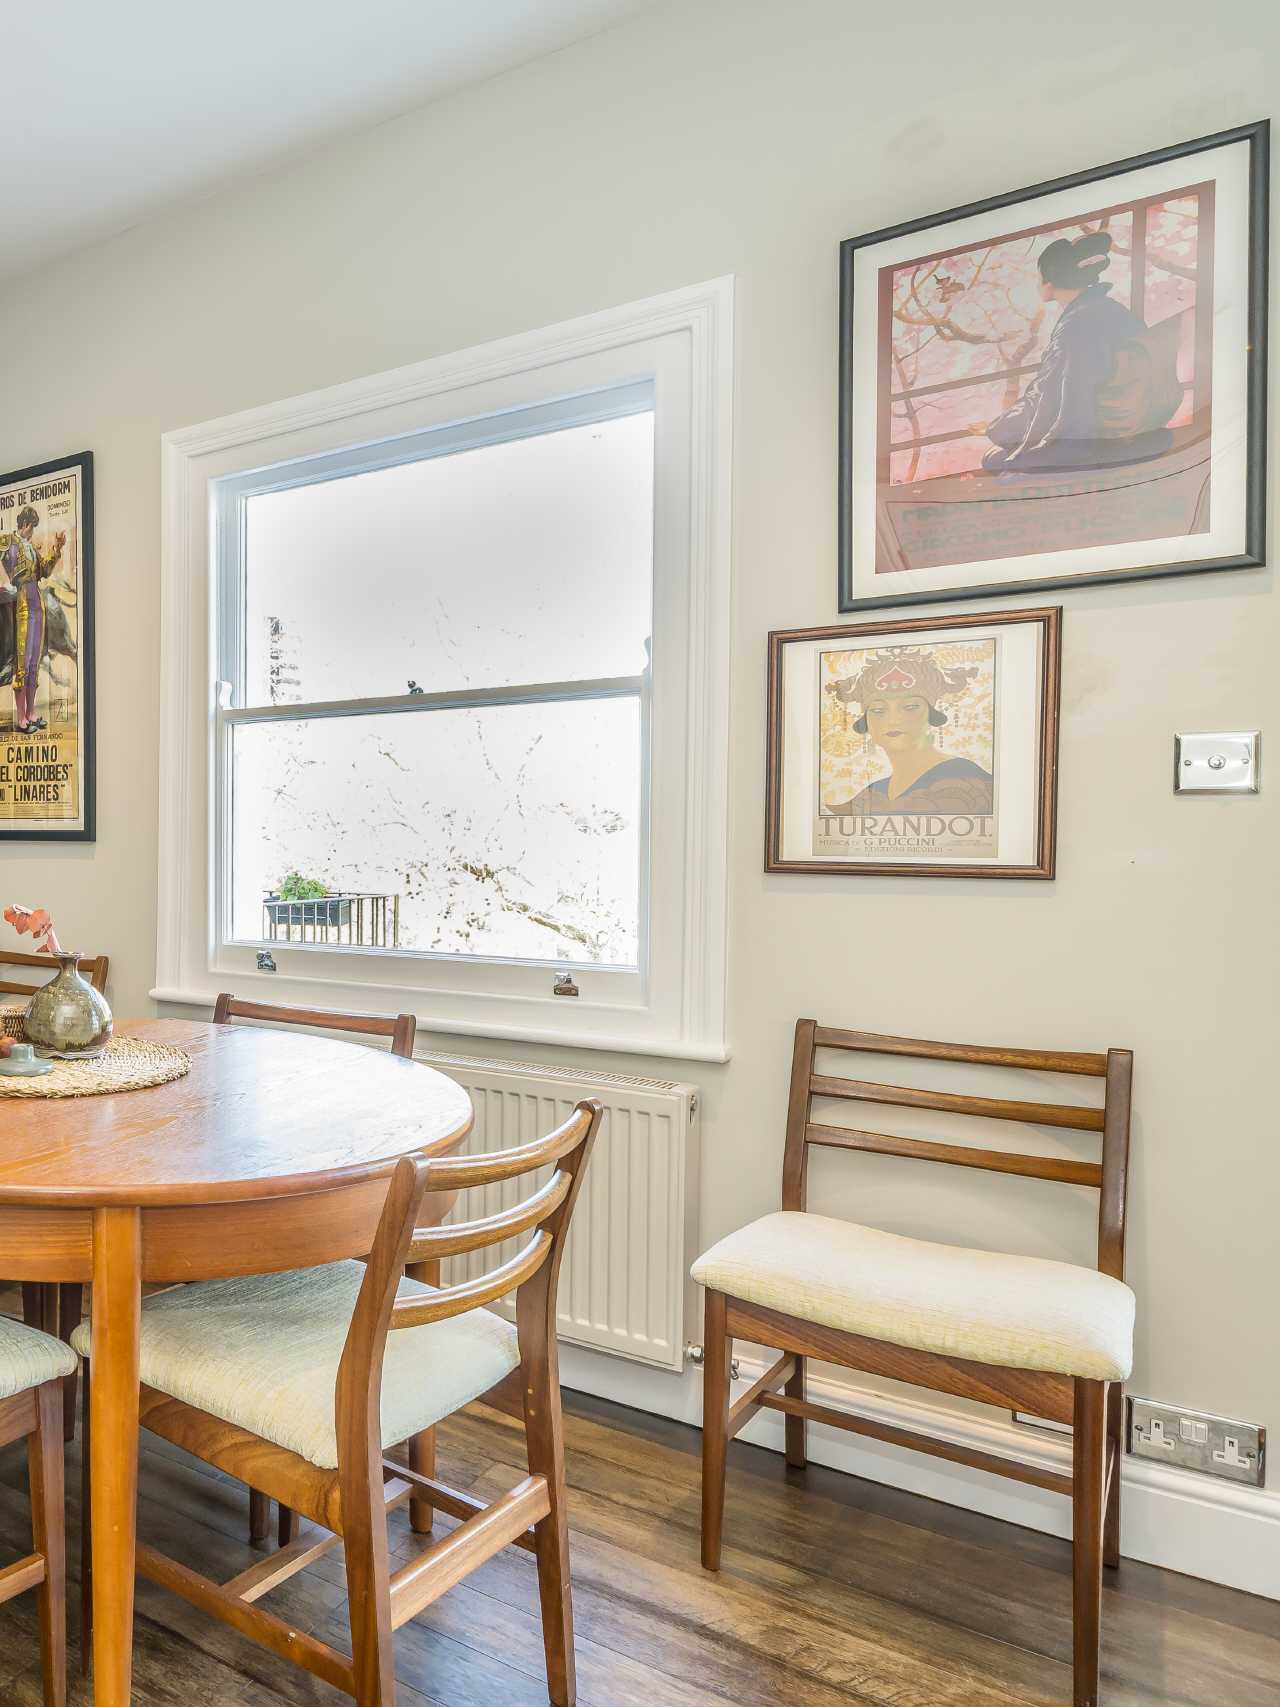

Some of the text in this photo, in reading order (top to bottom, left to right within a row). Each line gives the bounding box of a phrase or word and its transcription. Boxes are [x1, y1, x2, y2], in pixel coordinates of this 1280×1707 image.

[18, 491, 27, 506] DE
[30, 480, 71, 502] BENIDORM
[7, 745, 58, 763] CAMINO
[878, 838, 937, 846] PUCCINI
